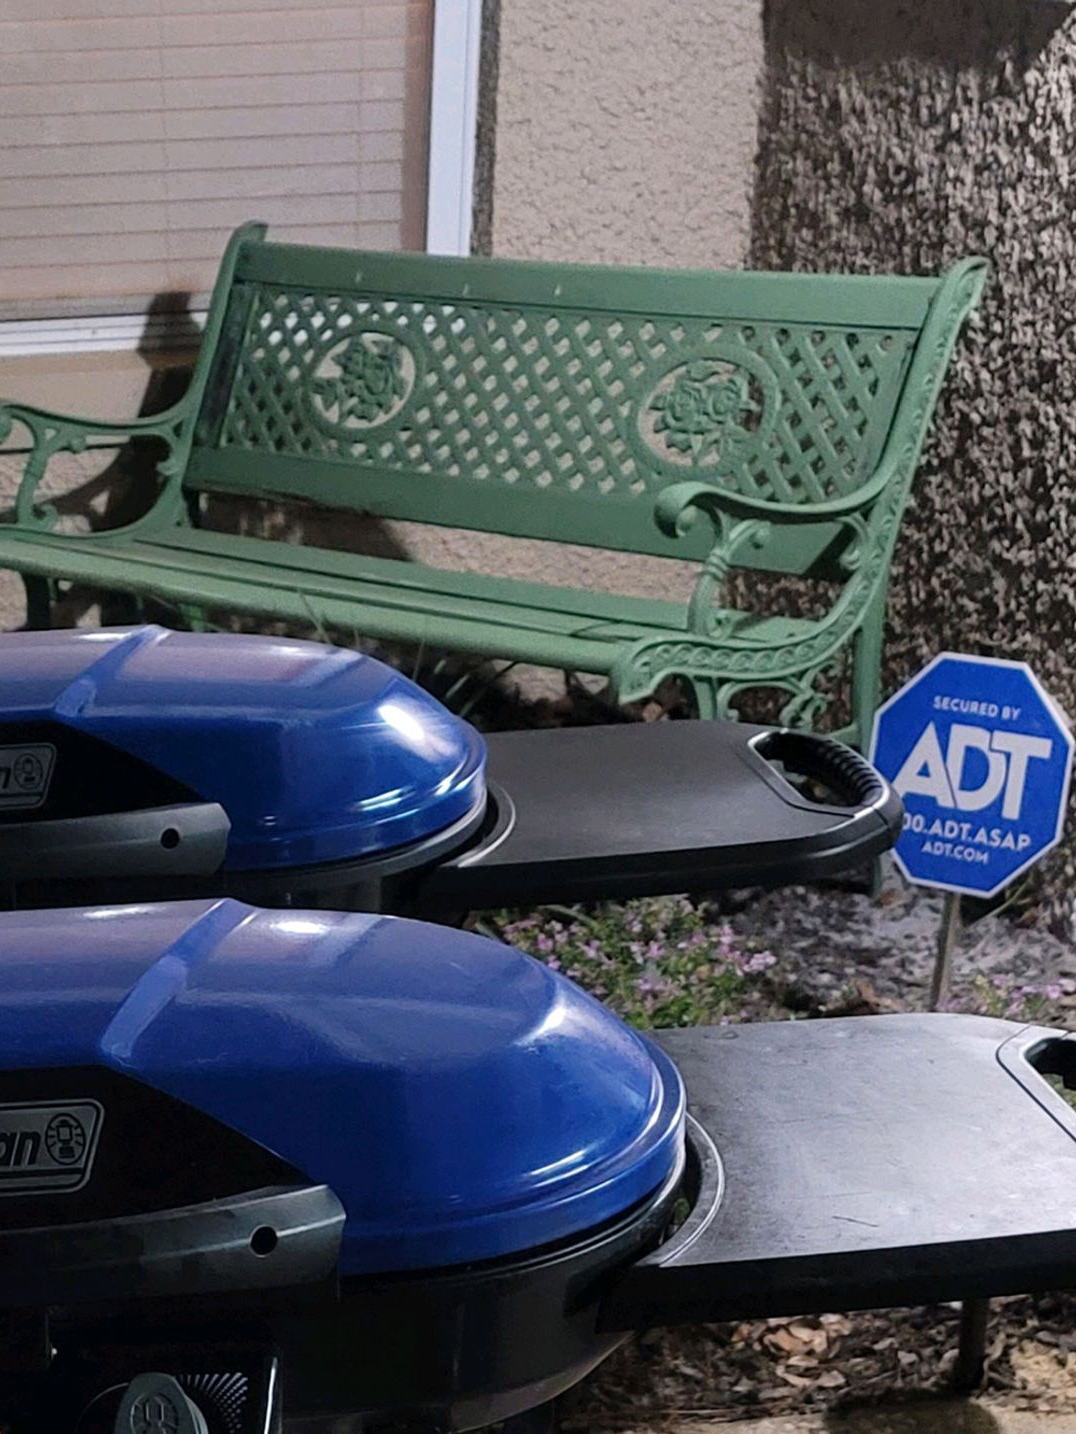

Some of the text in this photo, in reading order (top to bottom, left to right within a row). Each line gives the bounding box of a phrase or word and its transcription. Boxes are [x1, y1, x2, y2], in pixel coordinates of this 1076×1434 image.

[933, 695, 1022, 720] SECURED BY
[891, 720, 1053, 820] ADT
[903, 812, 1031, 851] 00.ADT.ASAP
[921, 841, 989, 864] ADT.COM
